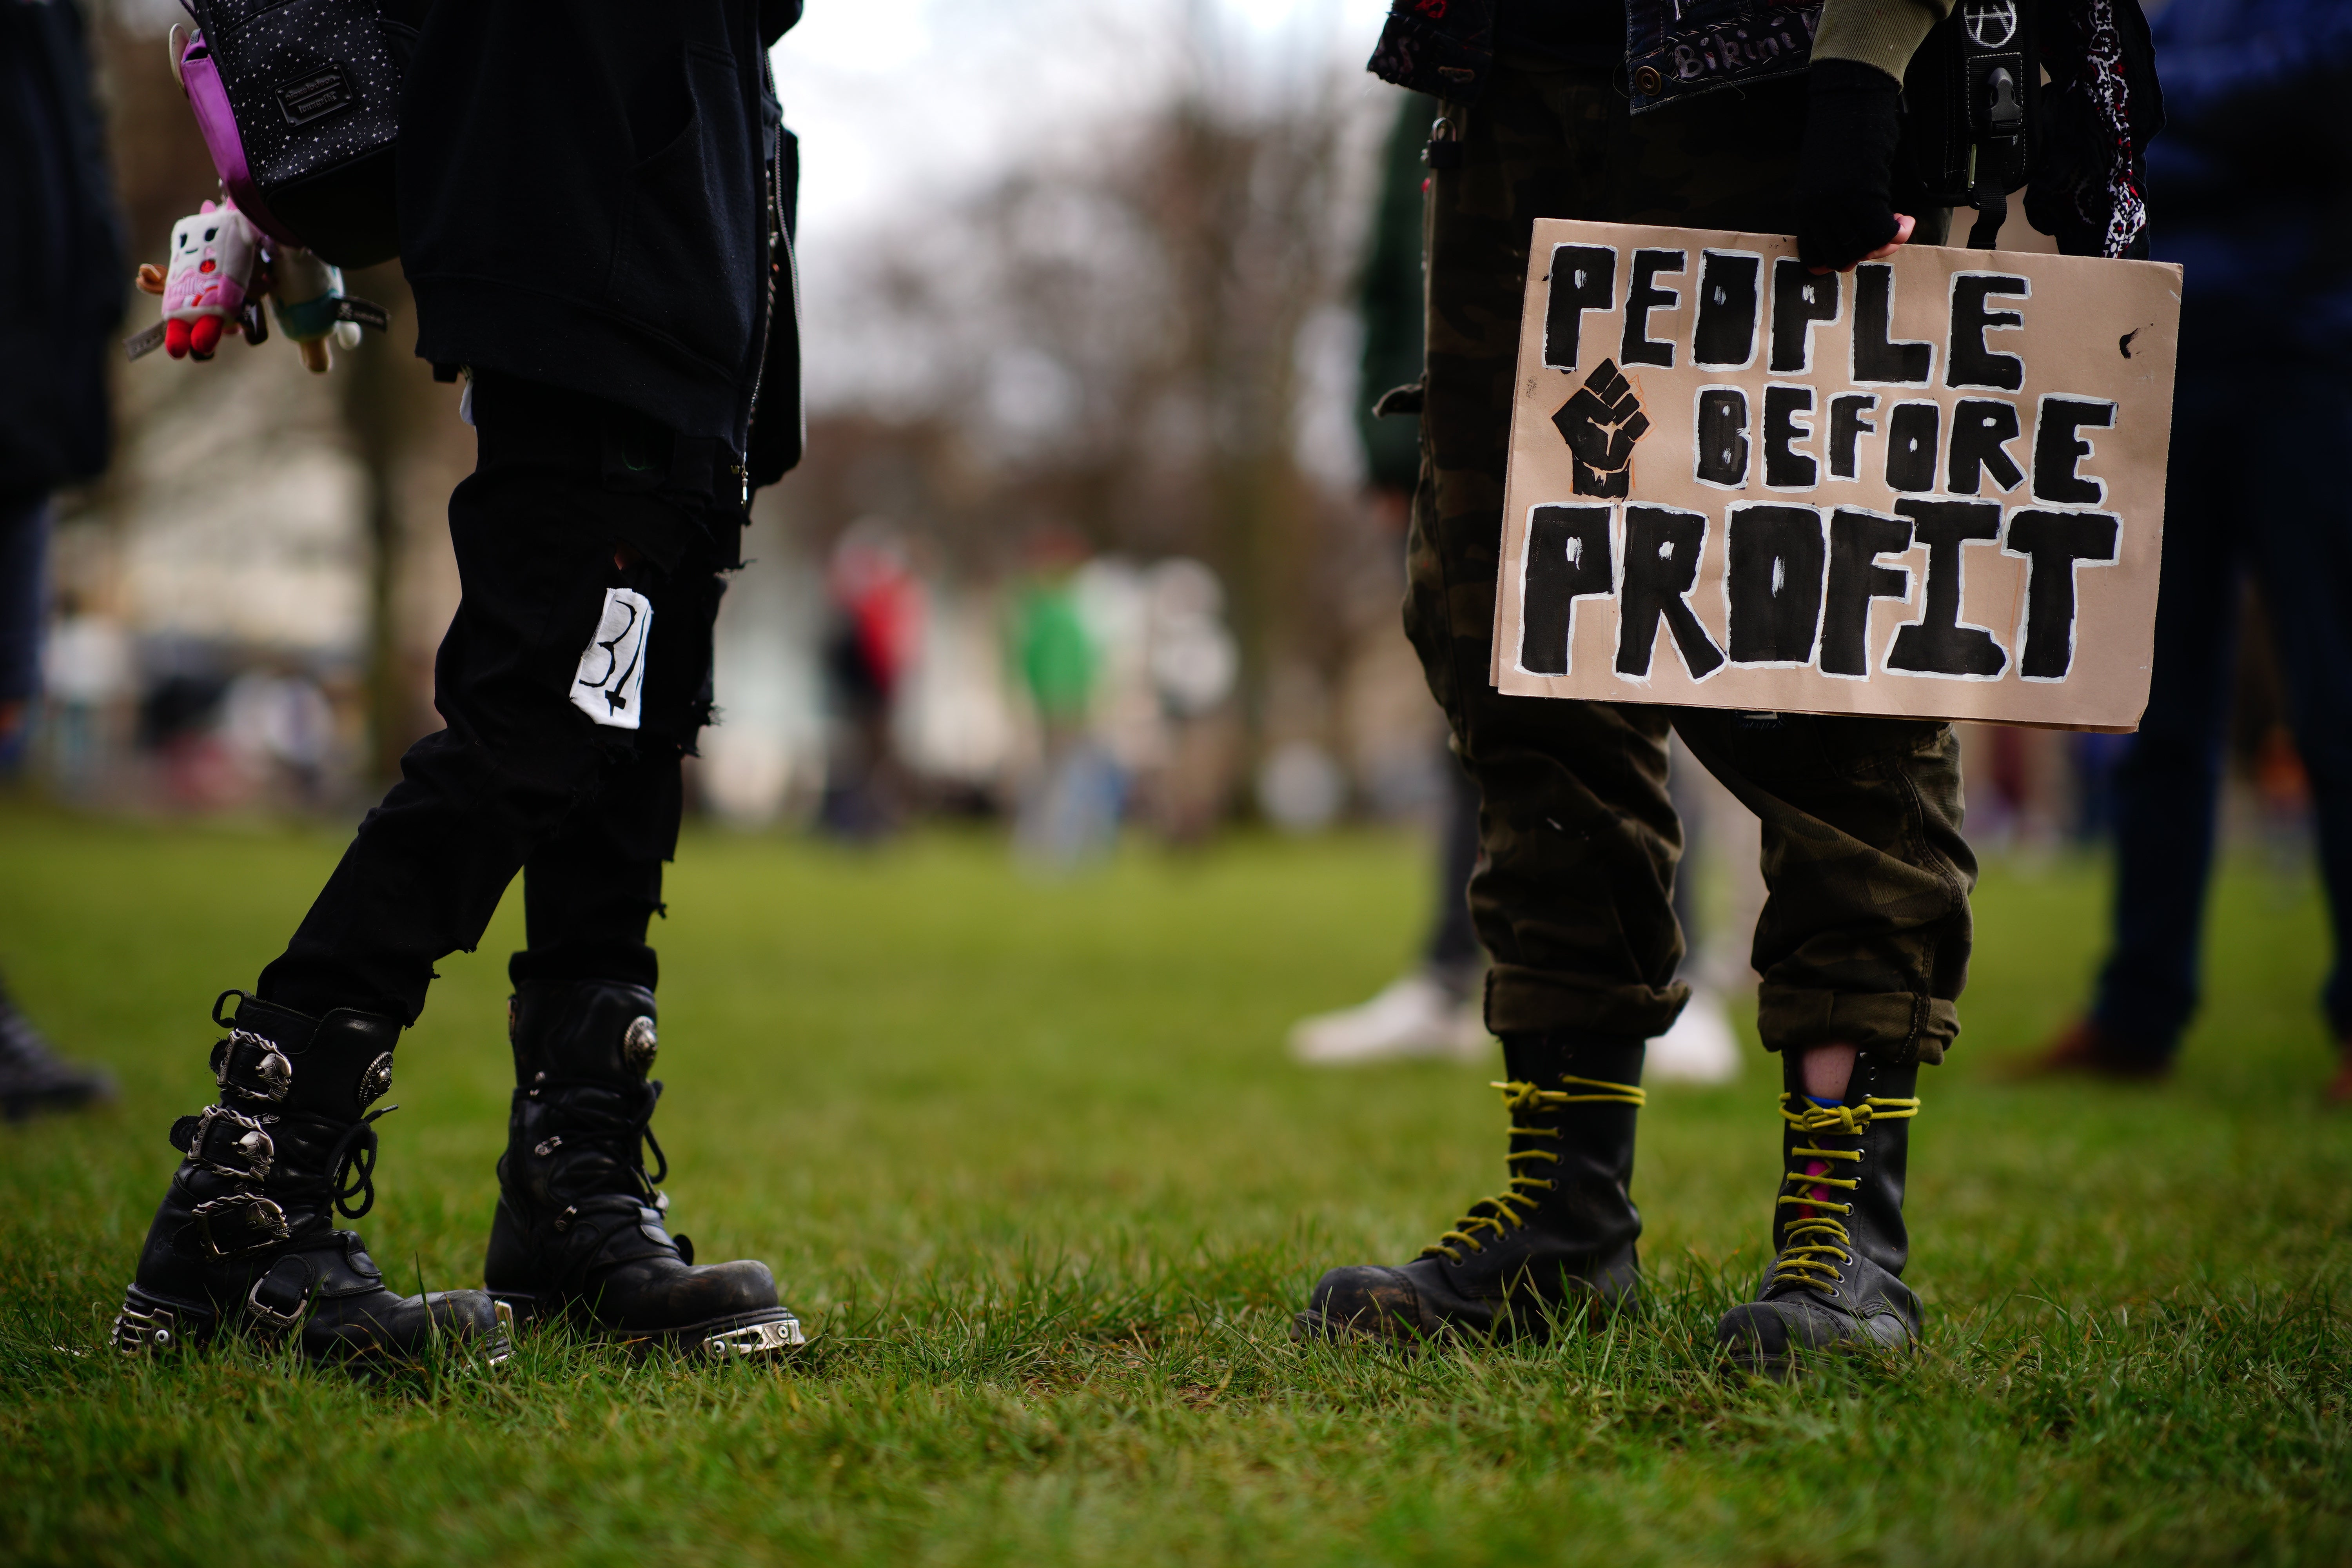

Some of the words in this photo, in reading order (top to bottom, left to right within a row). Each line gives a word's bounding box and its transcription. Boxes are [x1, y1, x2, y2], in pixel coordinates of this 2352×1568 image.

[1674, 16, 1796, 79] Bikini
[1541, 242, 2031, 392] PEOPLE
[1693, 382, 2118, 508] BEFORE
[1515, 494, 2123, 685] PROFIT
